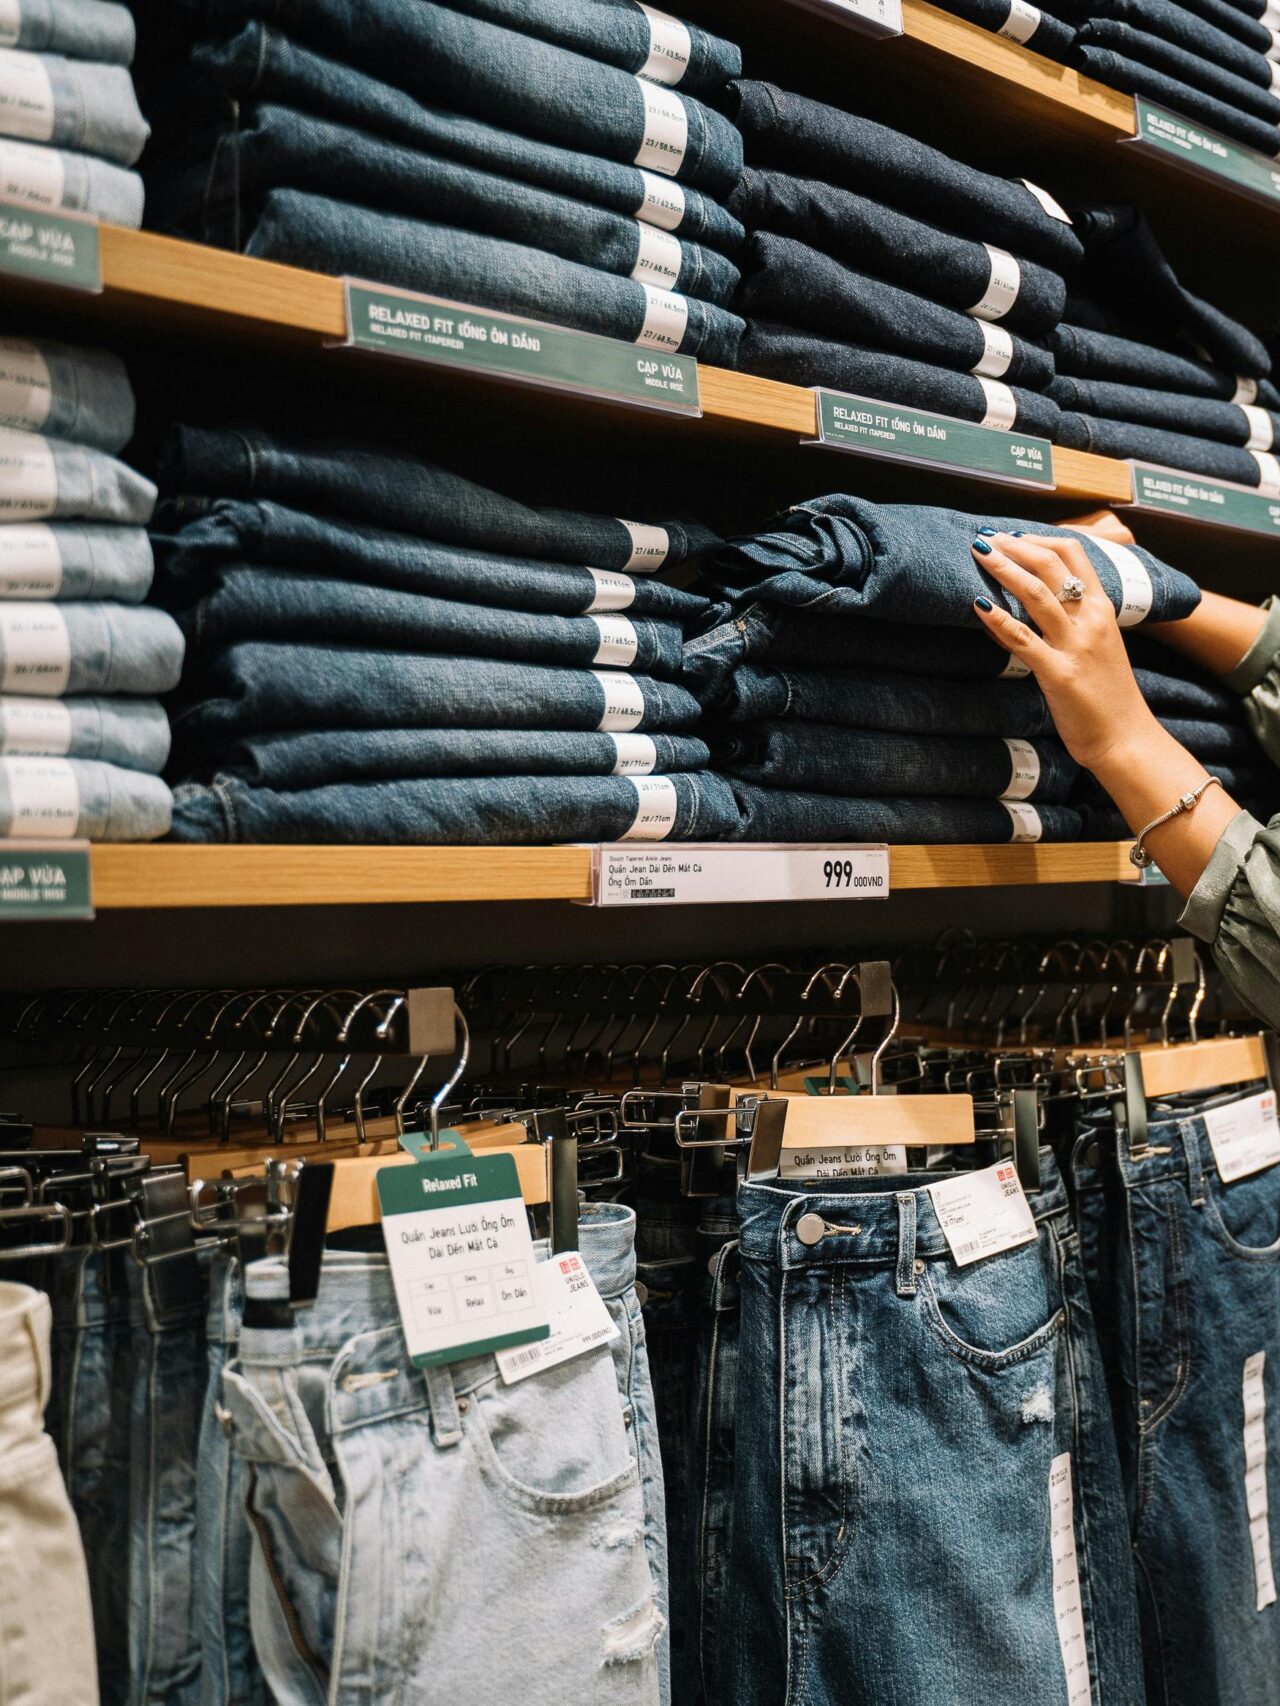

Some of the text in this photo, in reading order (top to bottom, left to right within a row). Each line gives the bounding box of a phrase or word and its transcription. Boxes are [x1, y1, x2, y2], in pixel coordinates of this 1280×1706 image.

[645, 138, 654, 147] 23
[659, 142, 682, 155] 58.5cm
[647, 195, 655, 203] 25
[660, 200, 682, 214] 63.5cm
[640, 259, 649, 268] 27
[653, 264, 677, 278] 68.5cm
[368, 304, 430, 330] RELAXED
[433, 317, 454, 334] FIT
[370, 323, 464, 350] RELAXED FIT (TAPERED)
[643, 330, 652, 338] 27
[656, 334, 680, 347] 68.5cm
[637, 360, 683, 380] CẠP VỪA
[645, 377, 684, 392] MIDDLE RISE
[833, 406, 873, 425] RELAXED
[875, 416, 888, 428] FIT
[833, 421, 896, 440] RELAXED FIT (TAPERED)
[1010, 445, 1026, 458] CẠP
[635, 547, 643, 555] 27
[647, 548, 666, 556] 68.5cm
[603, 635, 610, 643] 27
[615, 637, 635, 646] 68.5cm
[608, 706, 616, 714] 27
[621, 707, 642, 717] 68.5cm
[621, 760, 629, 768] 28
[654, 815, 671, 823] 71cm
[629, 865, 646, 873] Jean
[823, 860, 883, 888] 999 000VND
[818, 1154, 841, 1164] Jeans
[865, 1149, 880, 1164] Ống
[883, 1148, 896, 1160] Ôm
[422, 1173, 478, 1193] Relaxed Fit
[1000, 1180, 1017, 1190] UNIQLO
[1004, 1187, 1019, 1197] JEANS
[430, 1225, 456, 1239] Jeans
[565, 1272, 585, 1284] UNIQLO
[569, 1280, 589, 1293] JEANS
[466, 1298, 484, 1308] Relax
